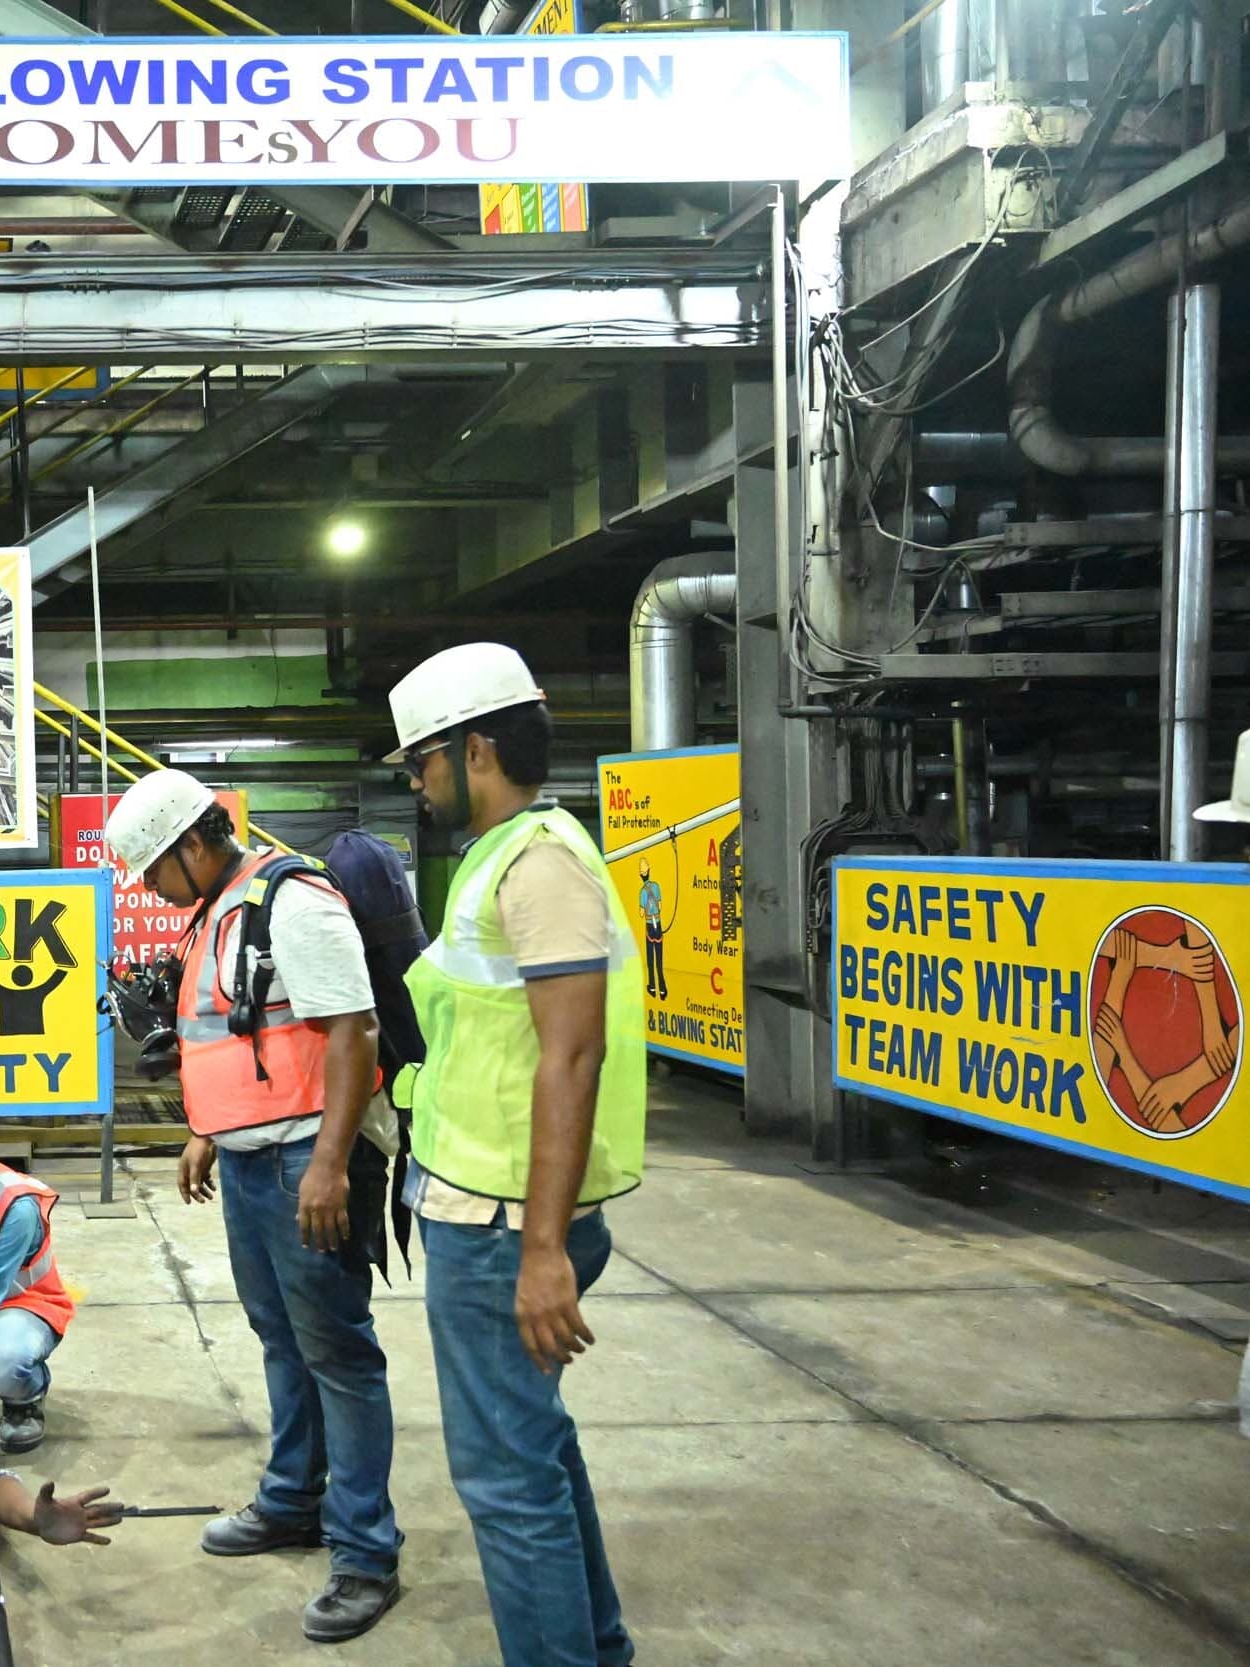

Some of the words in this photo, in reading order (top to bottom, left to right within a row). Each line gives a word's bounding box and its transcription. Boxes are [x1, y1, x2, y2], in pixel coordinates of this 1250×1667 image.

[322, 55, 675, 103] STATION
[605, 771, 621, 784] The
[78, 829, 105, 842] ROU
[608, 816, 621, 829] Fall
[622, 815, 661, 829] Protection
[707, 838, 719, 867] A
[693, 874, 720, 889] Ancho
[143, 915, 188, 933] YOU
[709, 902, 721, 931] B
[865, 882, 1046, 948] SAFETY
[692, 936, 713, 956] Body
[716, 939, 738, 957] Wear
[710, 966, 724, 995] C
[840, 944, 964, 1015] BEGINS
[973, 959, 1082, 1037] WITH
[686, 997, 729, 1024] Connecting
[648, 1009, 656, 1032] &
[658, 1010, 706, 1045] BLOWING
[844, 1013, 943, 1087] TEAM
[958, 1037, 1087, 1124] WORK
